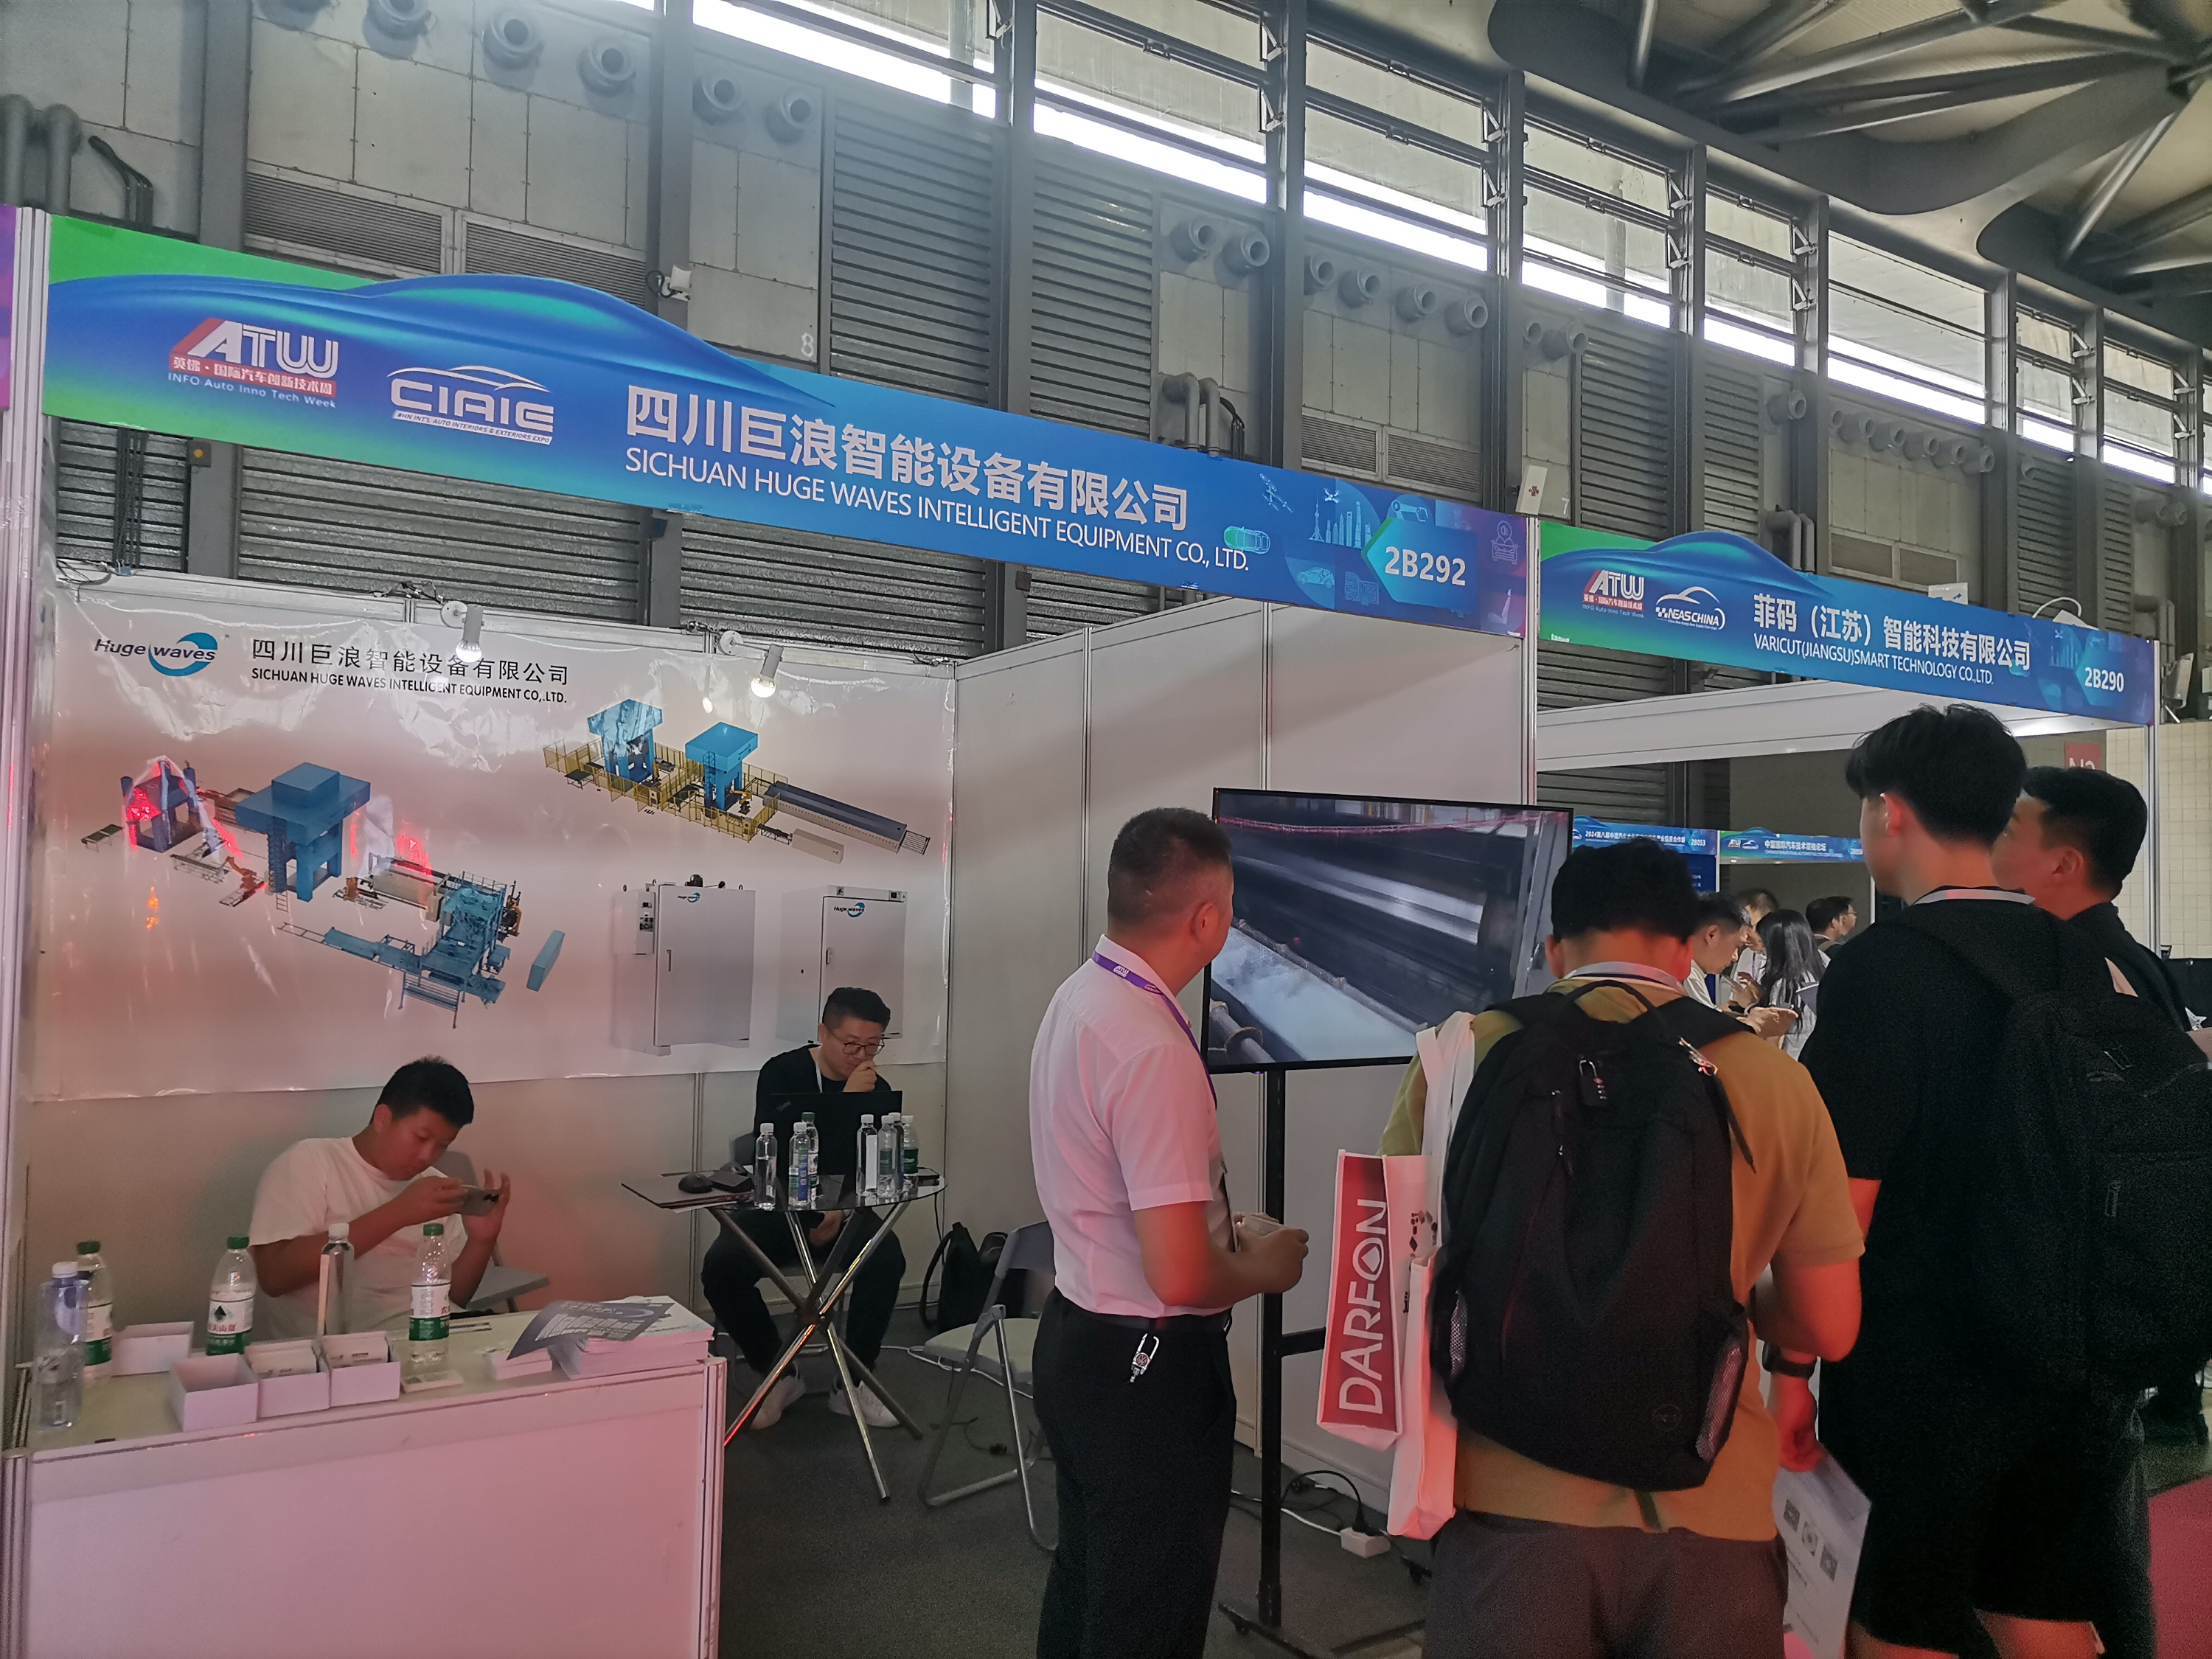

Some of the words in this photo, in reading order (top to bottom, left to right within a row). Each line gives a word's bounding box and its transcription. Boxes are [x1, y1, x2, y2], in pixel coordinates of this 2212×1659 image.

[187, 319, 339, 378] ATW
[801, 332, 814, 358] 8
[168, 372, 201, 386] INFO
[204, 378, 234, 392] Auto
[240, 384, 266, 397] Inno
[271, 389, 299, 402] Tech
[304, 395, 336, 408] Week
[391, 378, 554, 433] CIAIE
[414, 415, 431, 423] INT'L
[452, 422, 488, 433] INTERIORS
[495, 429, 532, 440] EXTERIORS
[532, 436, 550, 444] EXPO
[627, 384, 1187, 531] 四川巨浪智能设备有限公司
[625, 447, 747, 490] SICHUAN
[755, 468, 825, 502] HUGE
[830, 481, 911, 516] WAVES
[918, 496, 1051, 539] INTELLIGENT
[1056, 521, 1172, 559] EQUIPMENT
[1215, 546, 1250, 571] LTD.
[1562, 497, 1570, 515] 7
[1384, 546, 1467, 586] 2B292
[1588, 569, 1644, 601] ATW
[94, 639, 146, 657] Huge
[153, 644, 216, 661] waves
[252, 638, 568, 686] 四川巨浪智能设备有限公司
[1891, 654, 1958, 679] TECHNOLOGY
[251, 667, 307, 684] SICHUAN
[311, 672, 344, 686] HUGE
[346, 674, 386, 689] WAVES
[459, 684, 521, 700] EQUIPMENT
[2084, 667, 2124, 692] 2B290
[1339, 1199, 1386, 1414] DARFON
